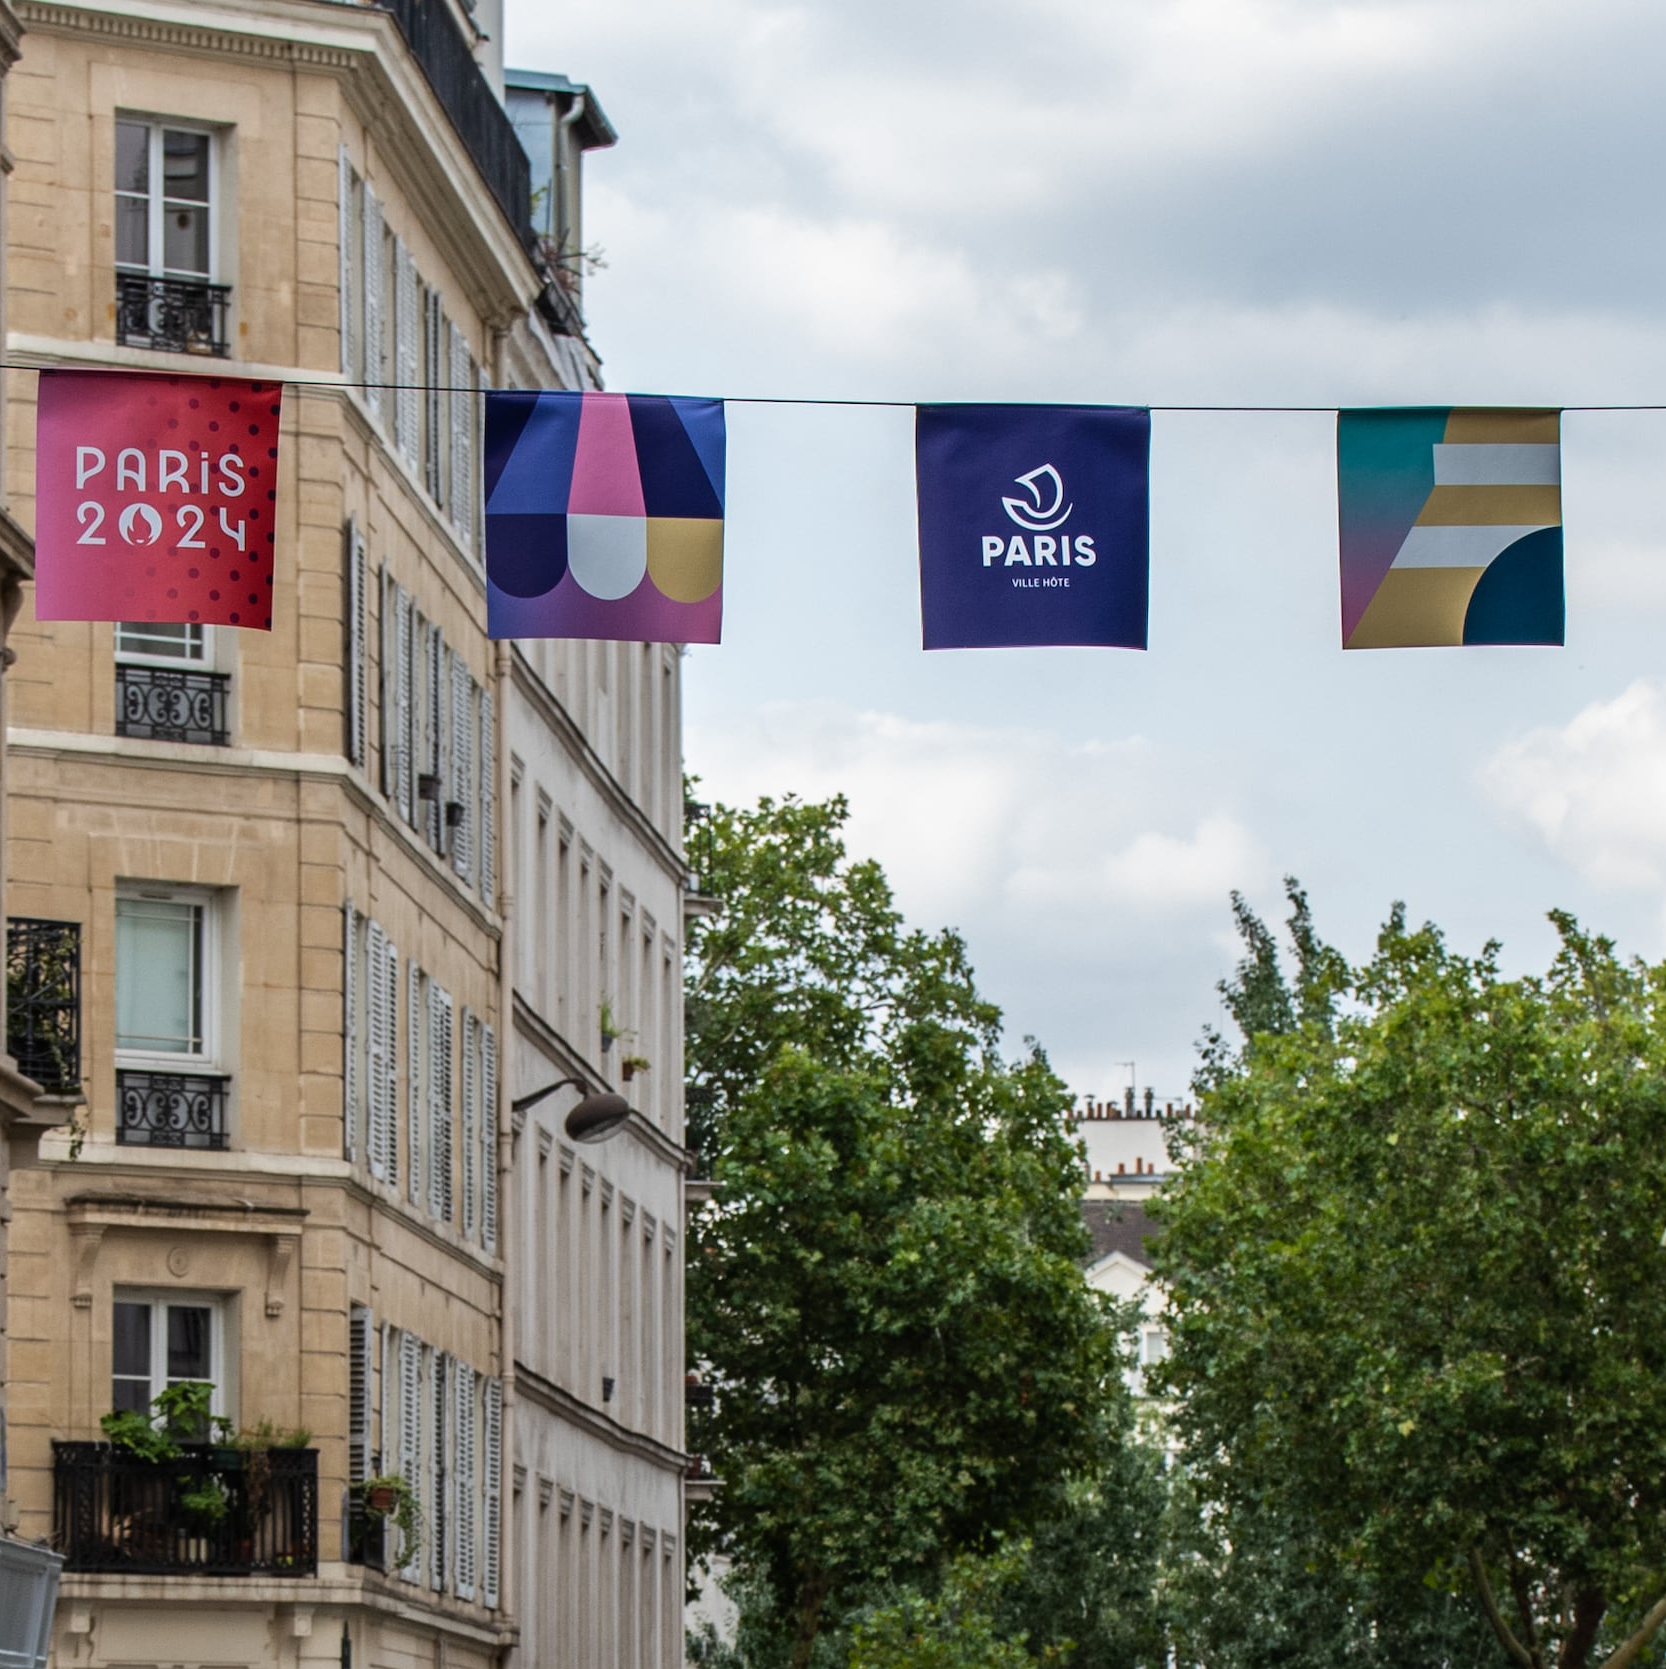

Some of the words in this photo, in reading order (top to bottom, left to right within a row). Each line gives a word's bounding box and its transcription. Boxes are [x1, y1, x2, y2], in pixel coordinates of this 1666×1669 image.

[76, 500, 246, 552] 2024
[982, 535, 1097, 567] PARIS
[1011, 577, 1041, 588] VILLE
[1042, 575, 1071, 588] HÔTE
